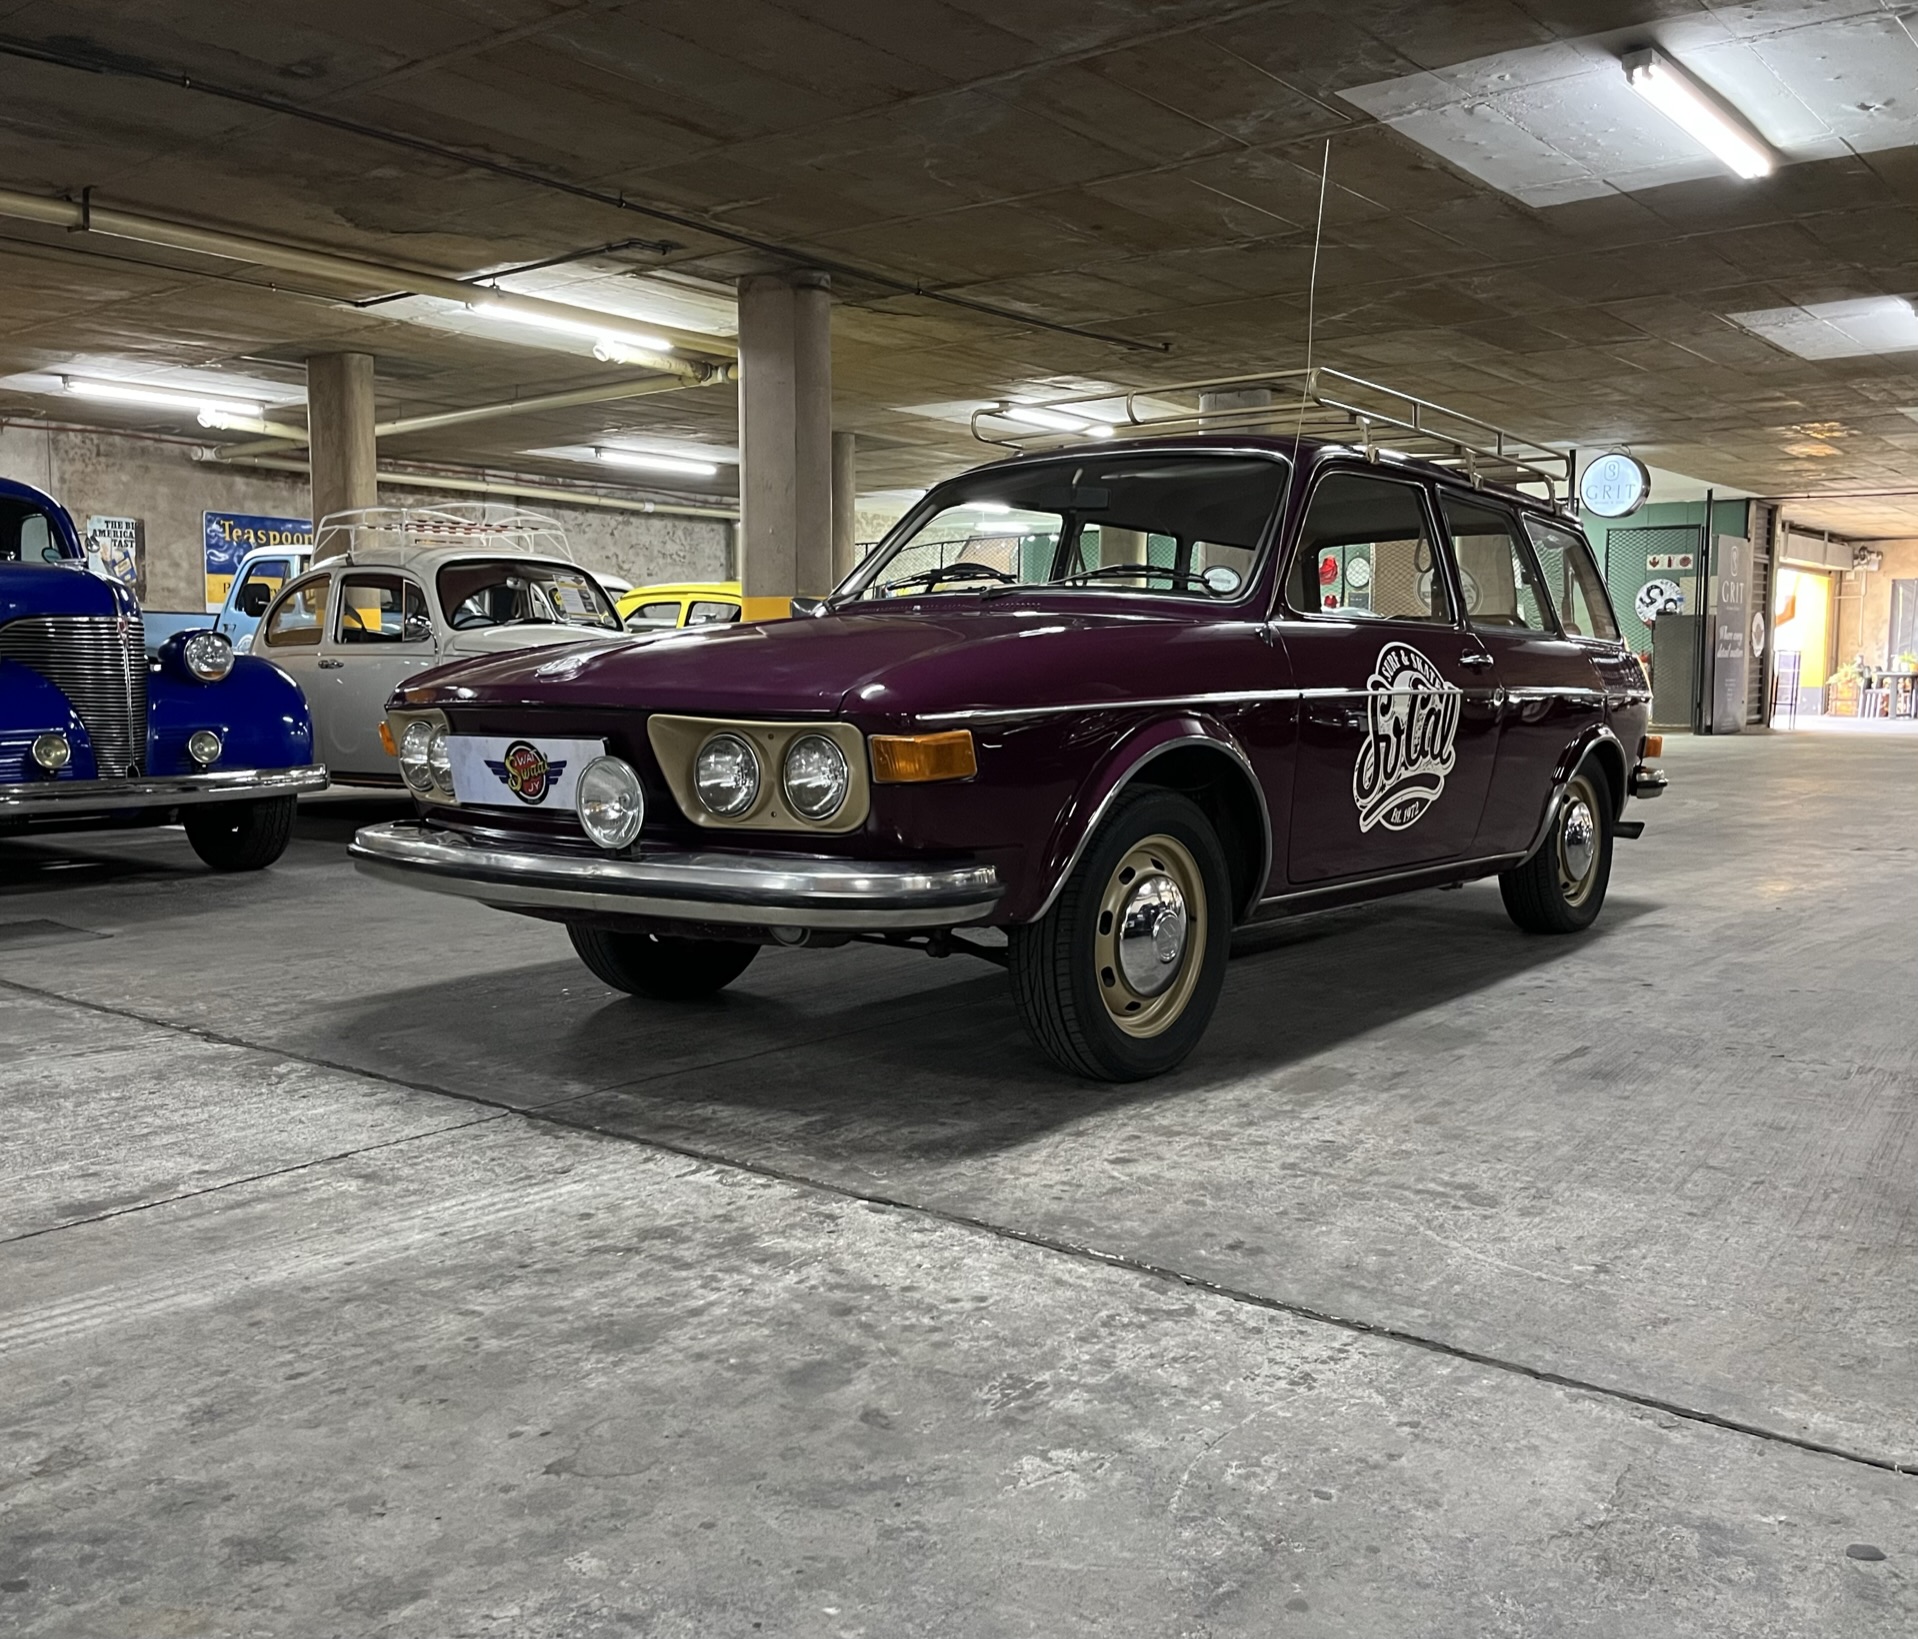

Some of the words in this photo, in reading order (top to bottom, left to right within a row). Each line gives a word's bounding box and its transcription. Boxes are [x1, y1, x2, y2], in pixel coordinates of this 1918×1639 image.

[1585, 484, 1636, 500] GRIT
[104, 520, 123, 529] THE
[125, 521, 137, 530] BI
[111, 539, 134, 548] TAST
[1721, 580, 1745, 604] GRIT
[1381, 650, 1401, 682] SURF
[1400, 649, 1410, 666] &
[1410, 653, 1442, 690] SKATE
[1402, 801, 1420, 823] 1972
